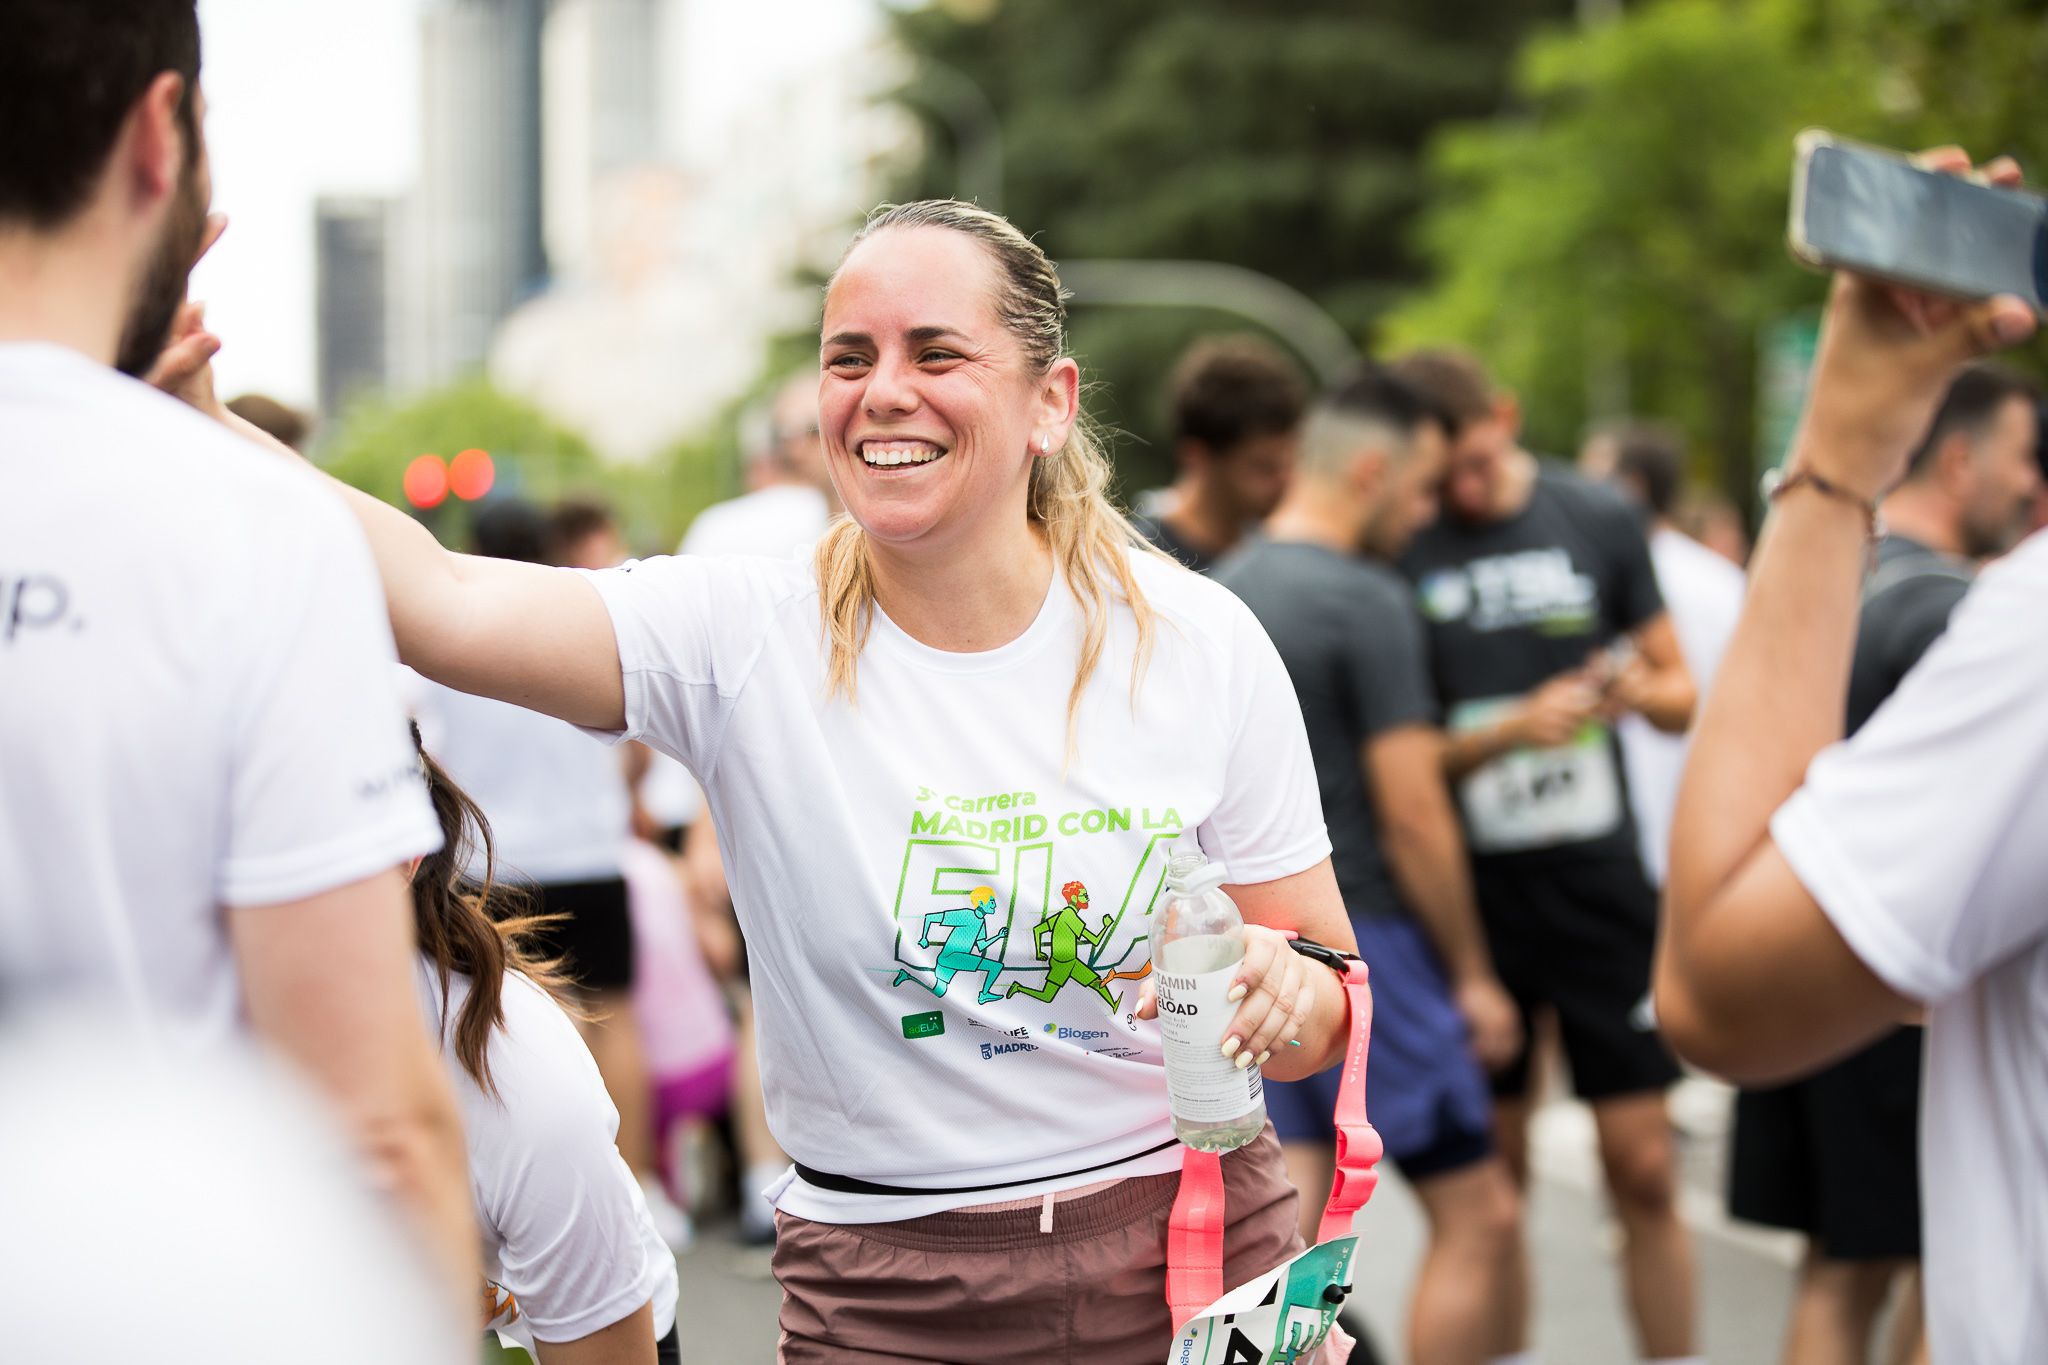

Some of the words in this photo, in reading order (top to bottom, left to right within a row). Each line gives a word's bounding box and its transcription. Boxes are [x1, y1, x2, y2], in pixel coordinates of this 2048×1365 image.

[944, 791, 1037, 813] Carrera
[910, 810, 1048, 843] MADRID
[1058, 808, 1131, 836] CON
[1142, 807, 1183, 829] LA
[1058, 1027, 1109, 1041] Biogen
